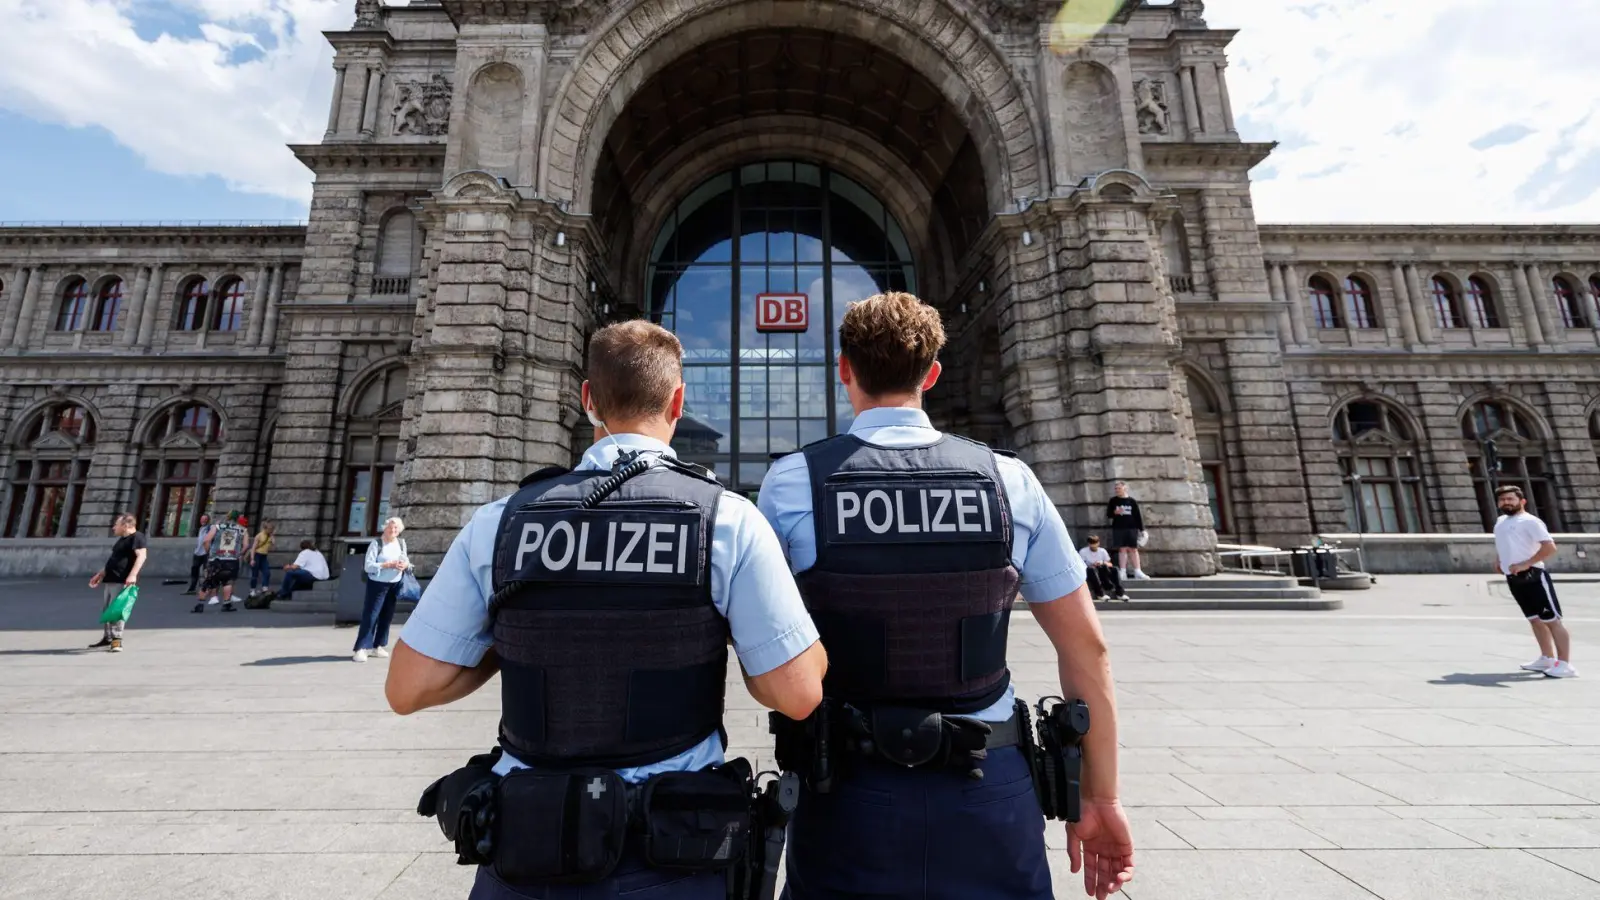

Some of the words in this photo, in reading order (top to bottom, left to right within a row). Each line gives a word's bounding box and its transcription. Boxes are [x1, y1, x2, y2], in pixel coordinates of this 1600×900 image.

[763, 299, 804, 323] DB
[836, 489, 992, 535] POLIZEI
[514, 520, 688, 574] POLIZEI
